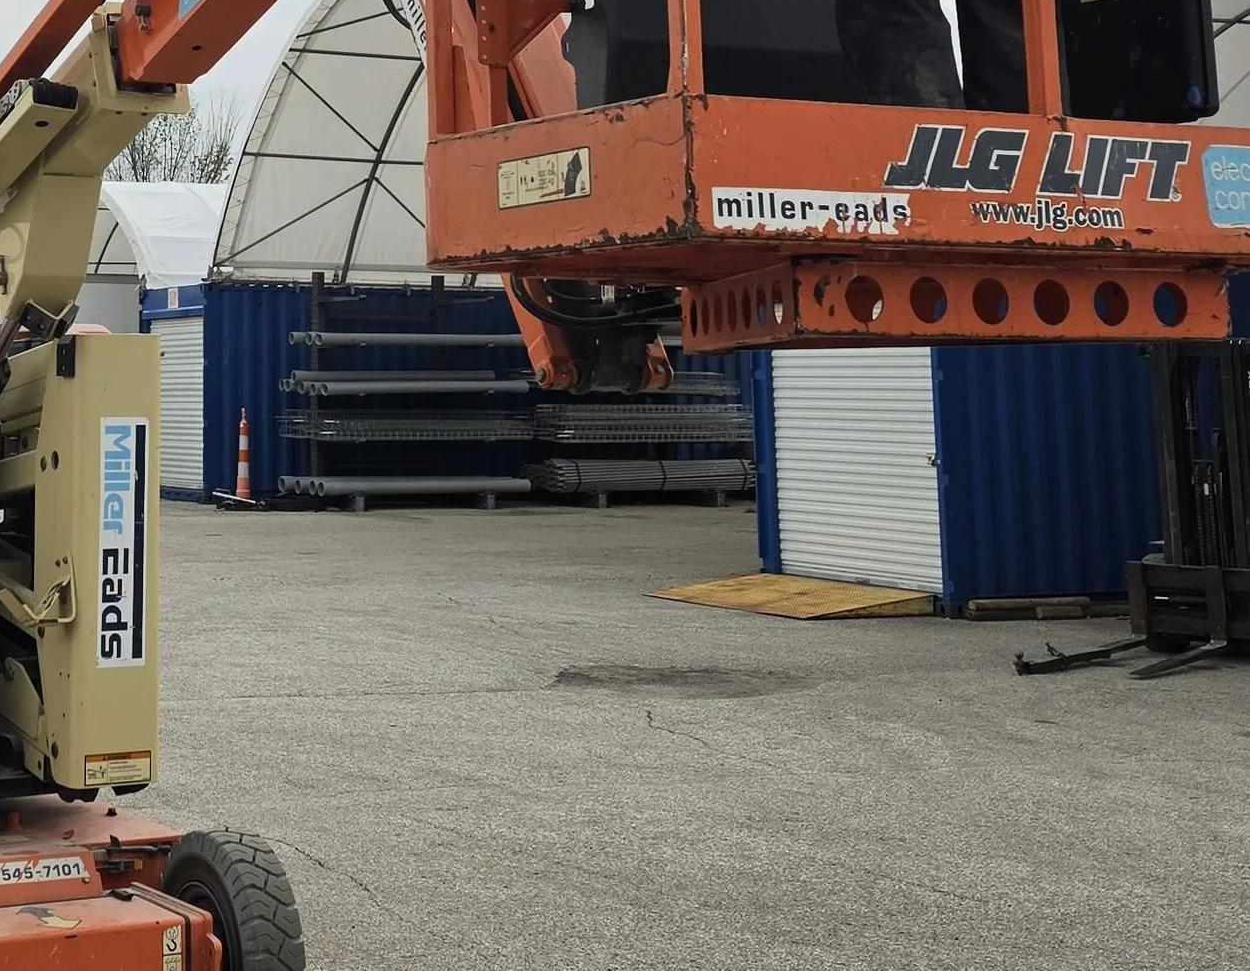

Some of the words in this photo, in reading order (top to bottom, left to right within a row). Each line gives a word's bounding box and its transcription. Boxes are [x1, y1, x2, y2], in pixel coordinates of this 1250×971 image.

[883, 124, 1029, 194] JLG
[1036, 131, 1191, 202] LIFT
[717, 191, 908, 224] miller-eads
[970, 200, 1124, 230] www.jlg.com
[103, 424, 132, 535] Miller
[100, 547, 129, 660] Eads
